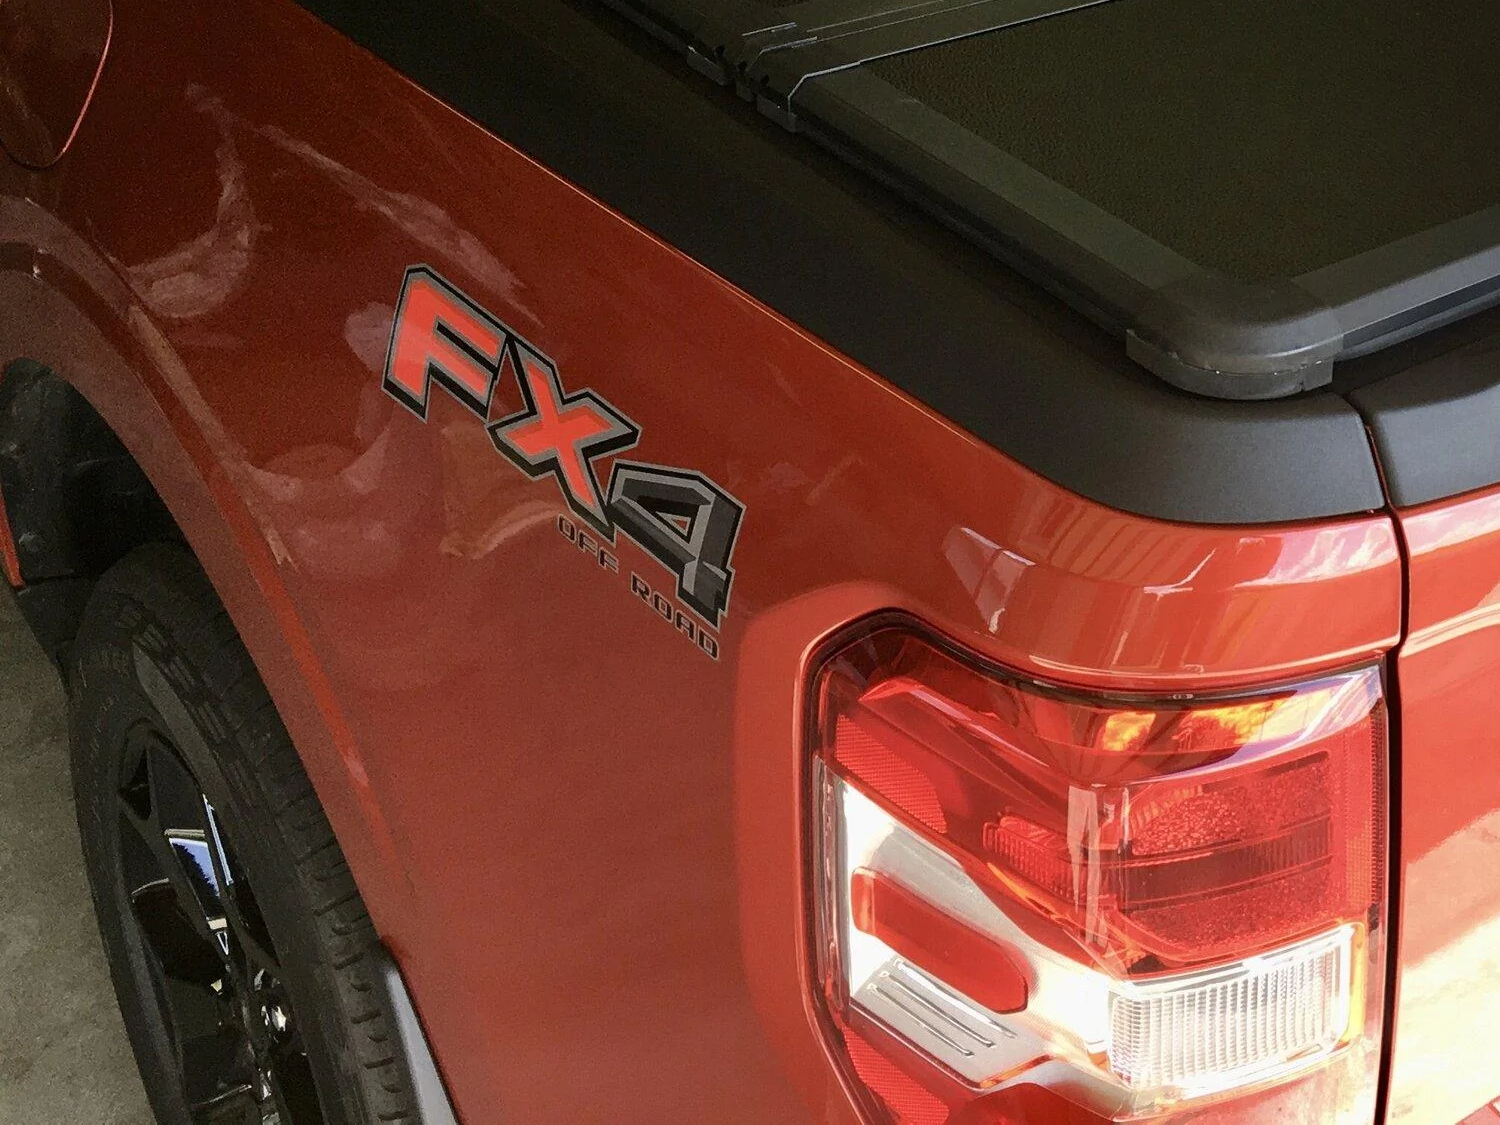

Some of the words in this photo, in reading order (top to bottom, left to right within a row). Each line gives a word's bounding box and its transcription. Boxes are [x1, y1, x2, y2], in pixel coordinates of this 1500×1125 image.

[382, 263, 746, 632] FX4
[557, 513, 620, 575] OFF
[630, 570, 721, 662] ROAD
